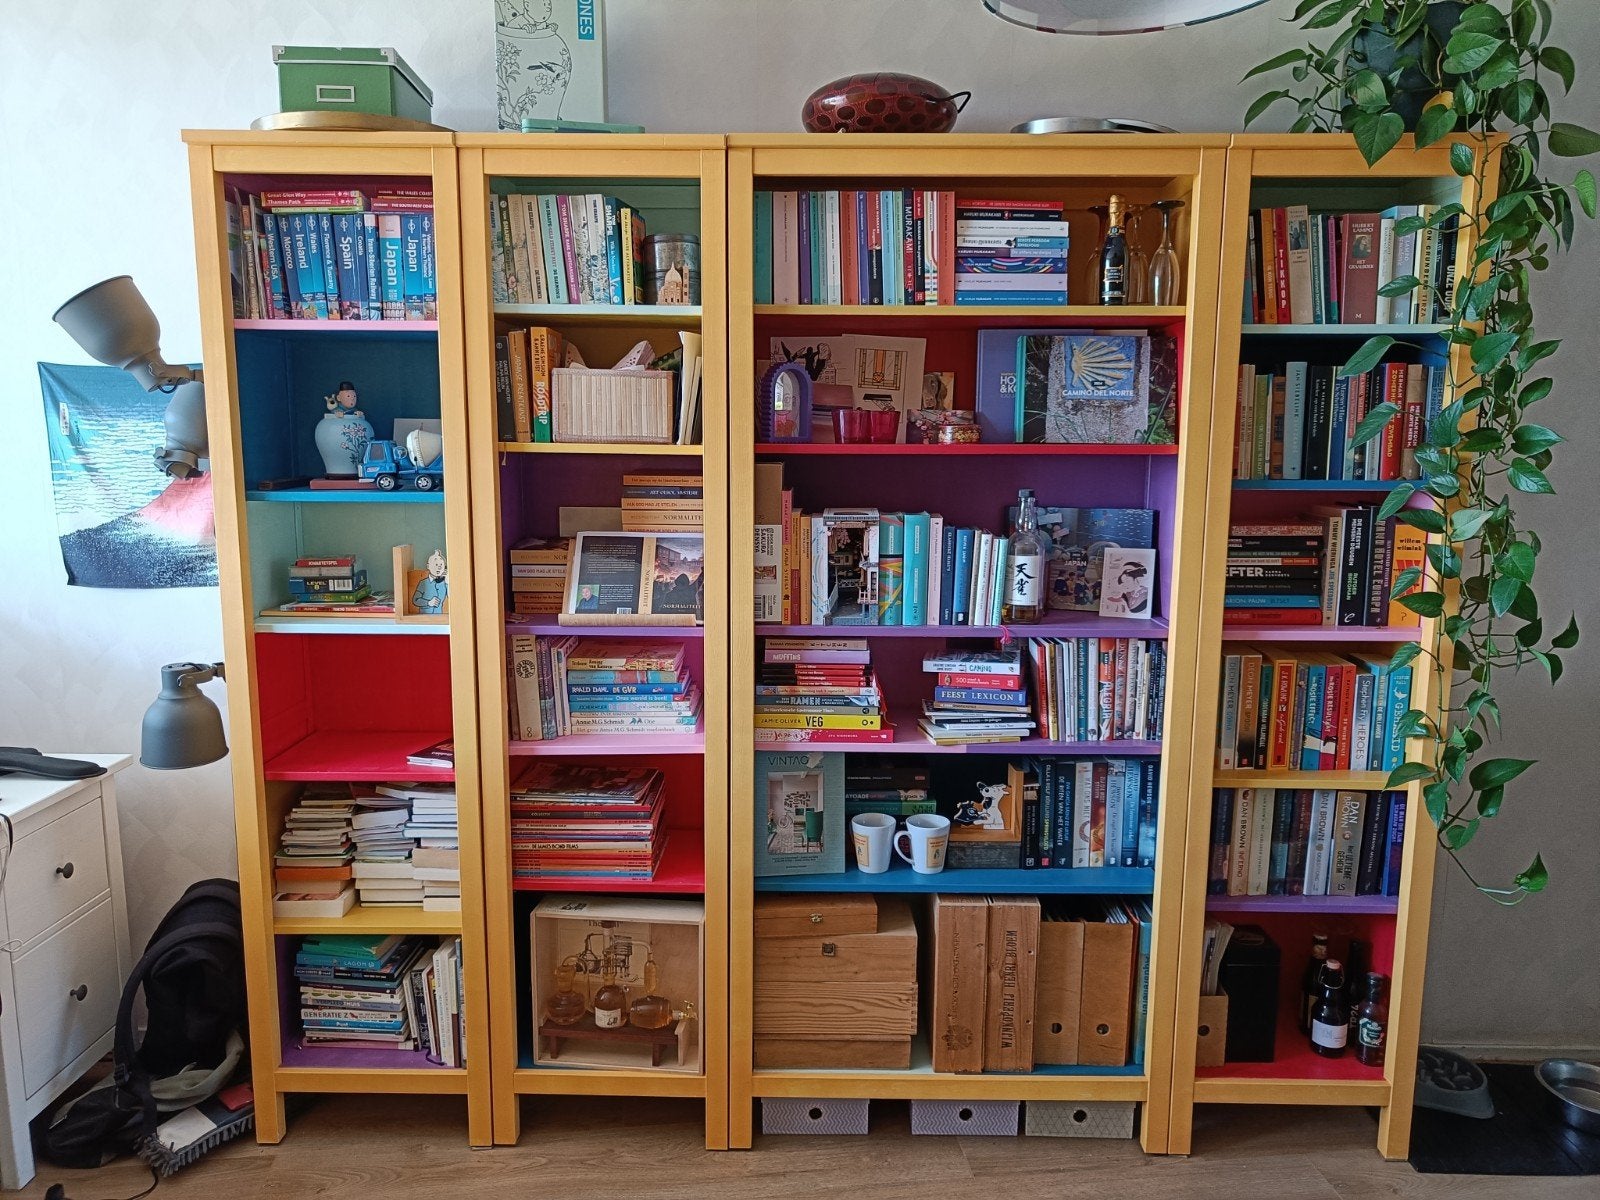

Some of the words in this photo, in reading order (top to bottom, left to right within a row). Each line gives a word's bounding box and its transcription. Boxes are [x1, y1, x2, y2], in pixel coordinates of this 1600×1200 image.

[605, 205, 613, 236] SHARPE
[904, 206, 914, 254] MURAKAMI
[1426, 212, 1434, 241] AON
[267, 233, 275, 263] Western
[283, 236, 293, 269] Morocco
[296, 234, 308, 269] Ireland
[340, 237, 352, 269] Spain
[406, 236, 418, 272] Japan
[270, 263, 278, 280] USA
[384, 241, 398, 285] Japan
[1423, 245, 1432, 290] GRUNBERG
[326, 267, 334, 290] Tuscany
[370, 277, 378, 300] Railway
[1420, 294, 1428, 318] TIRZA
[1389, 369, 1397, 404] ZOMERHU
[537, 382, 547, 425] ROADTRIP
[1387, 425, 1395, 457] ZWEMBAD
[1329, 542, 1337, 569] WIERINGA
[1012, 562, 1035, 596] 天雀
[1229, 662, 1237, 684] DEON
[1248, 663, 1256, 683] DEON
[790, 697, 821, 705] RAMEN
[972, 692, 1014, 700] LEXICON
[1227, 685, 1236, 709] MEYER
[1245, 685, 1254, 709] MEYER
[1309, 683, 1317, 701] ROSIE
[1360, 680, 1370, 709] Stephen
[605, 717, 625, 725] Schmidt
[806, 716, 823, 727] VEG
[1358, 709, 1369, 721] Fry
[1356, 724, 1366, 760] HEROES
[767, 756, 809, 766] VINTAG
[1241, 801, 1249, 818] DAN
[1320, 793, 1330, 809] DAN
[1341, 796, 1351, 828] BROWN
[1349, 801, 1359, 824] DAN
[1239, 819, 1247, 848] BROWN
[1318, 811, 1328, 841] BROWN
[1336, 850, 1346, 874] GEHEIM
[1007, 930, 1018, 958] BLOEM
[1004, 958, 1017, 989] HENRI
[1002, 993, 1015, 1048] WIJNKOPERIJ
